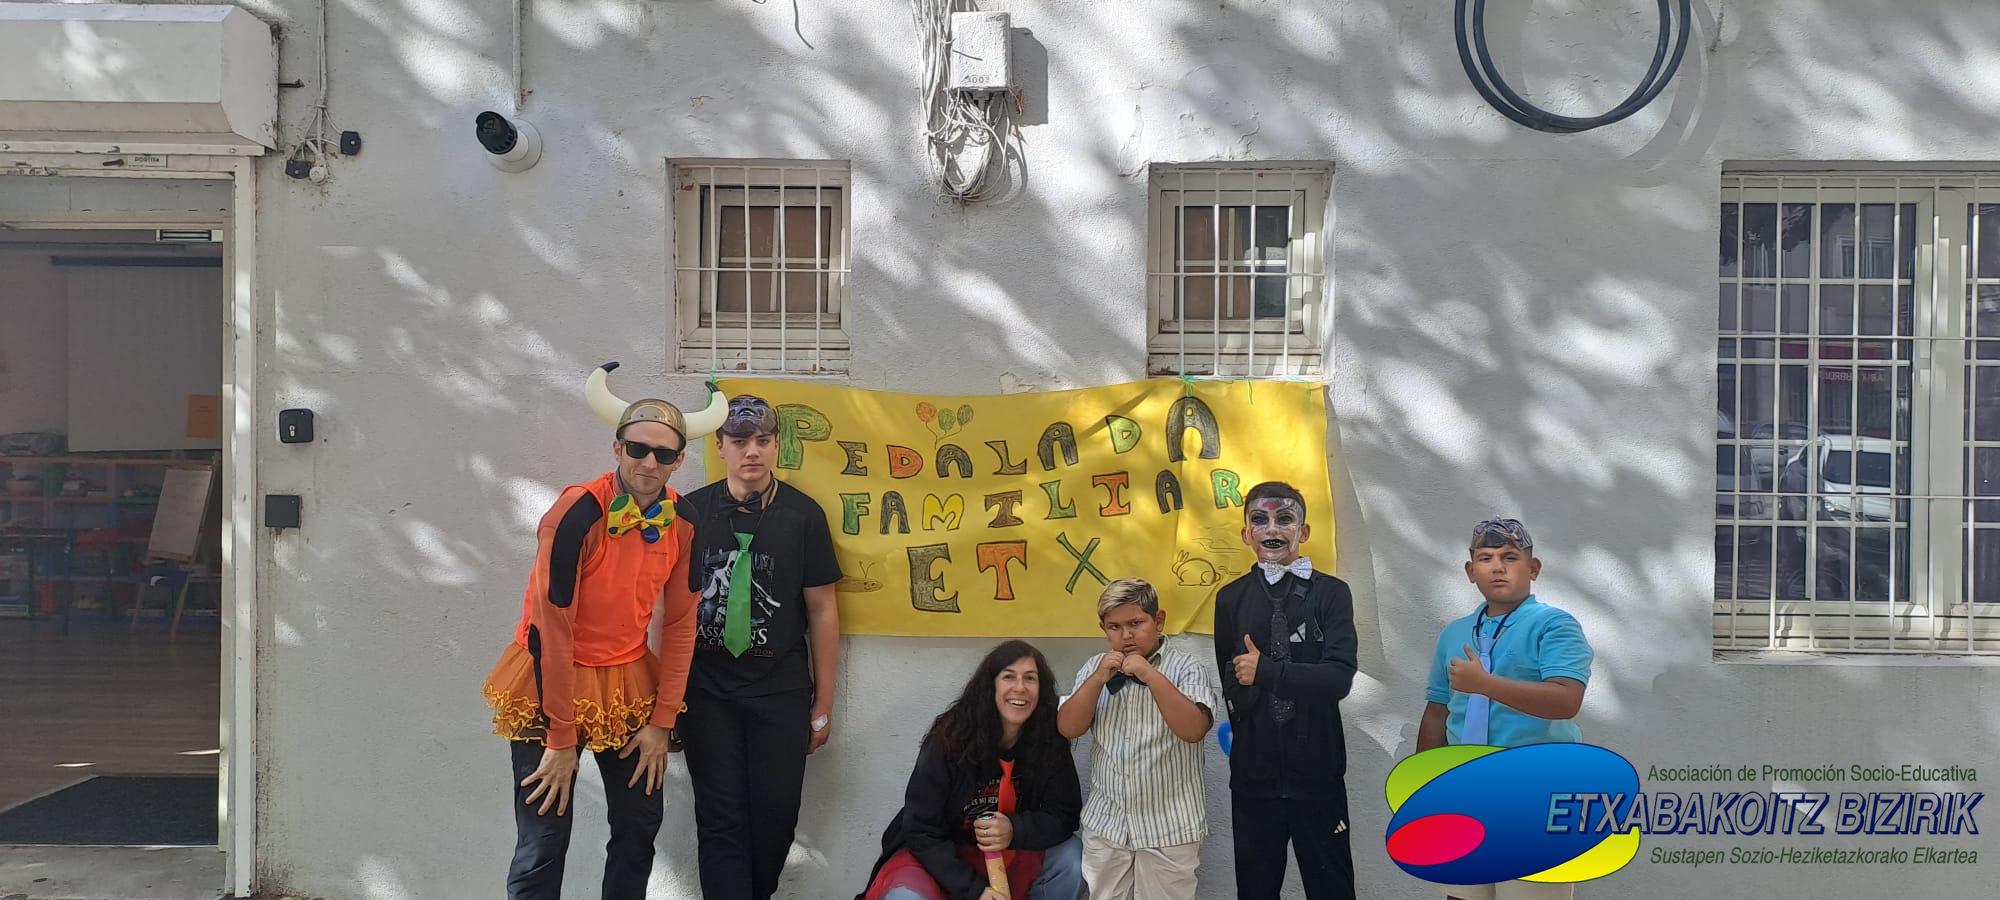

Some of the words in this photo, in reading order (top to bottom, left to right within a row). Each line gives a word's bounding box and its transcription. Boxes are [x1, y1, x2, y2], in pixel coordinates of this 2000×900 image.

[775, 396, 1221, 479] PEDALADA
[839, 468, 1244, 536] FAMILIAR
[906, 532, 1111, 614] ETX
